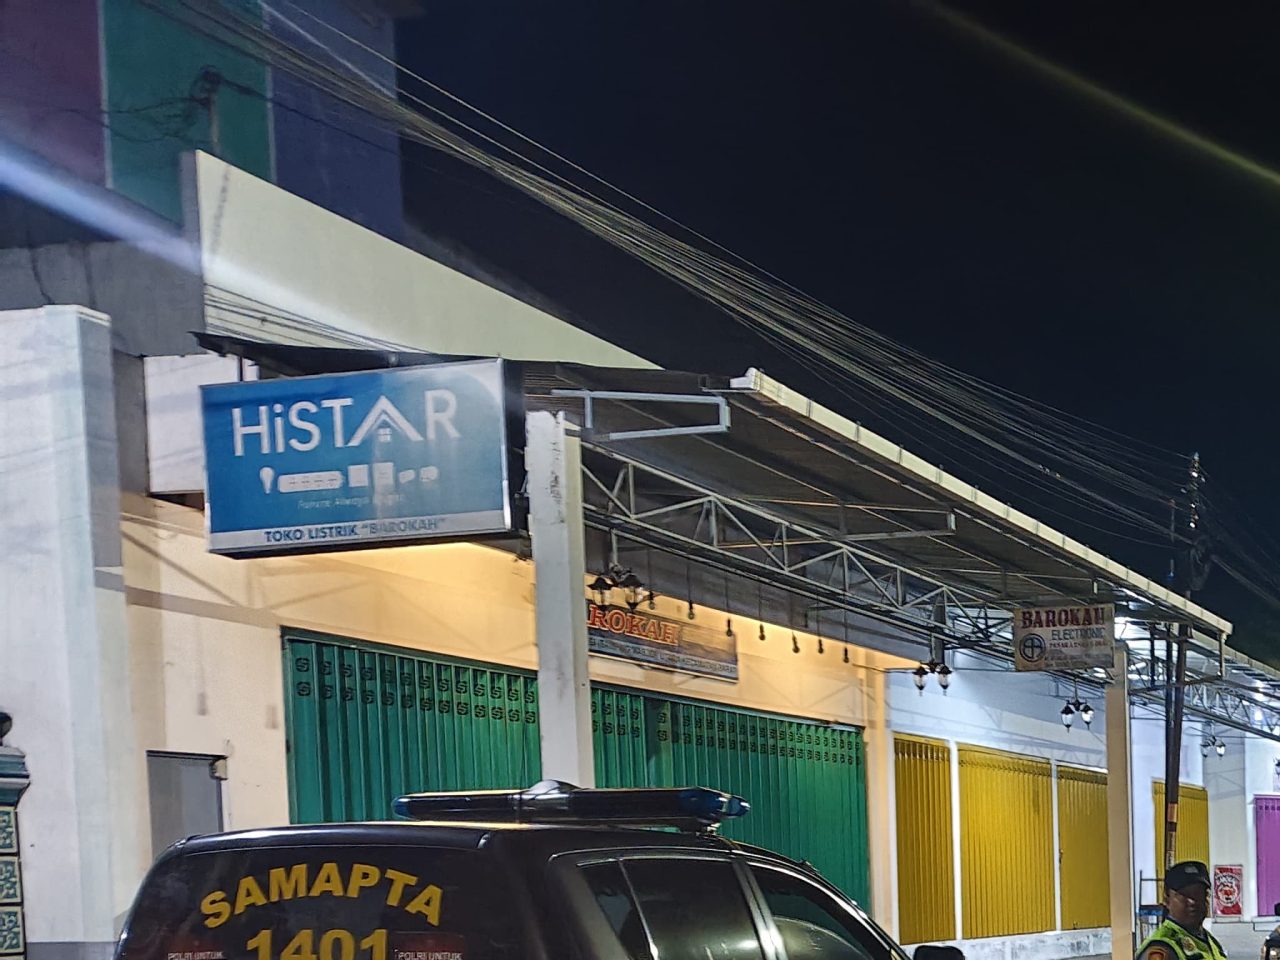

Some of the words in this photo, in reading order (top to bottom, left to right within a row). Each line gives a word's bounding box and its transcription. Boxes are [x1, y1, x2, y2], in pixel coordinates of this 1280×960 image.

[231, 389, 461, 456] HiSTAR
[264, 528, 304, 543] TOKO
[308, 524, 359, 540] LISTRIK
[586, 604, 680, 646] ROKAH
[1021, 607, 1106, 629] BAROKAH
[200, 862, 443, 928] SAMAPTA
[398, 952, 427, 960] POLRI
[428, 952, 462, 960] UNTUK
